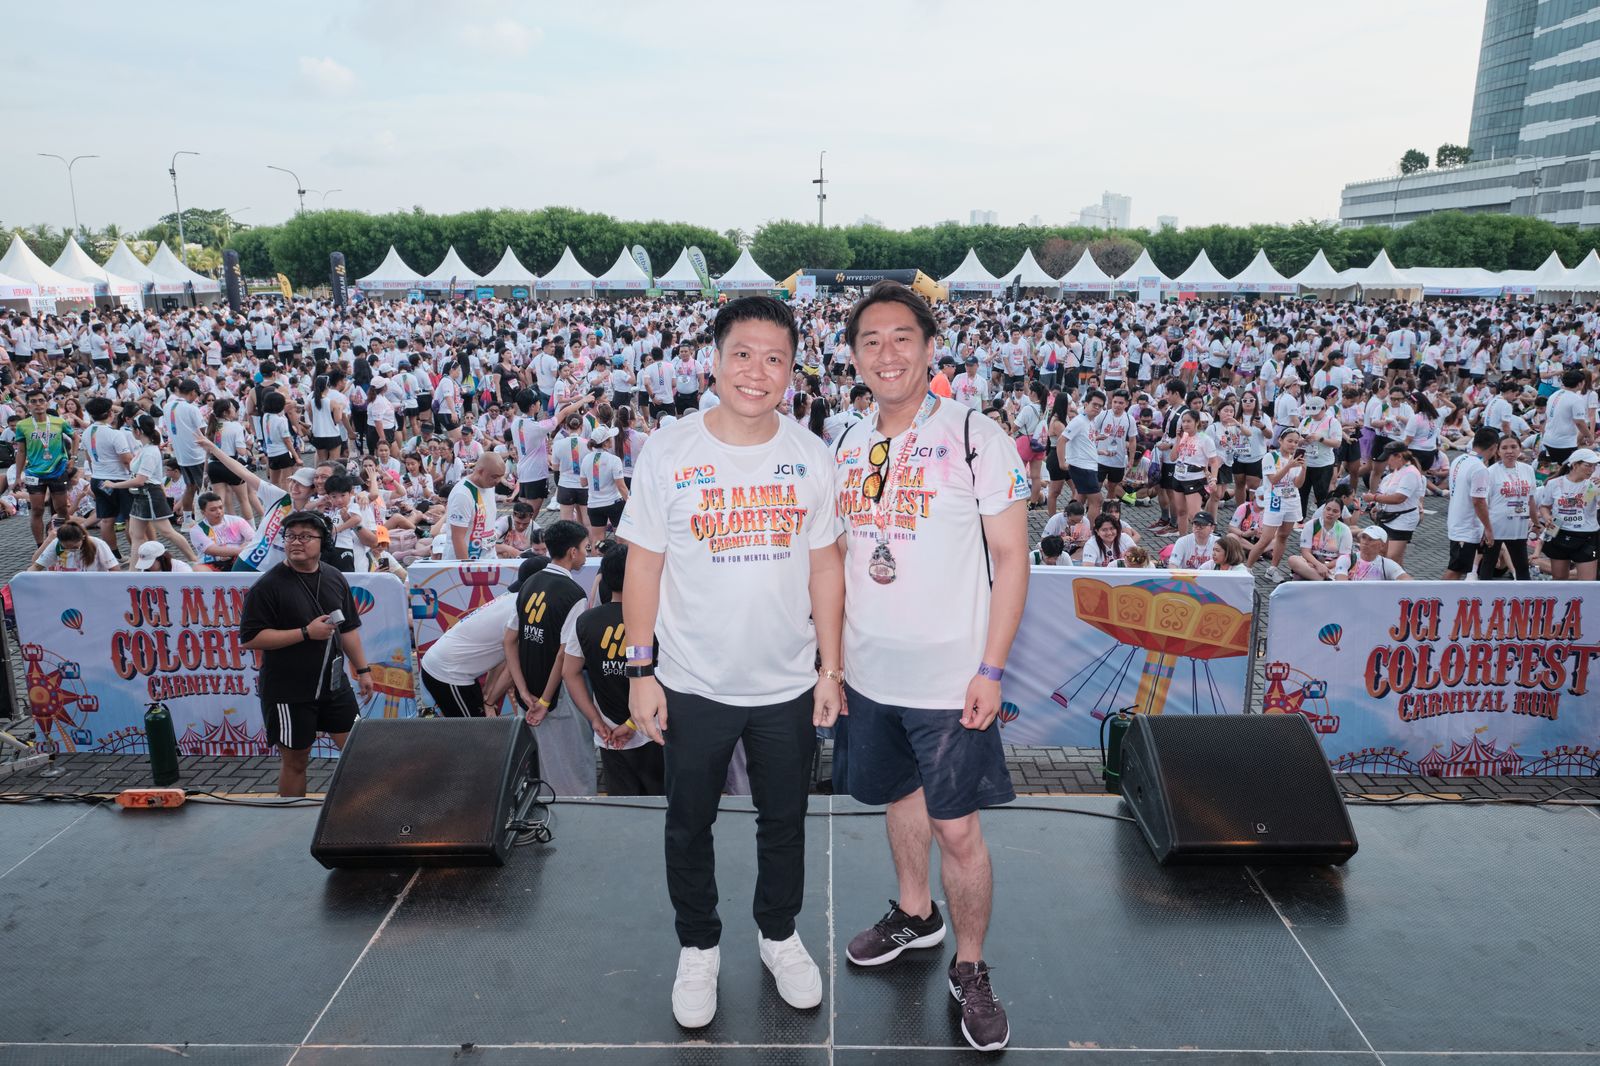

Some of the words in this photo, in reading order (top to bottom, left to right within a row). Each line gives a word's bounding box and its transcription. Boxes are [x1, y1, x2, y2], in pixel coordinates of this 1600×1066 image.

[636, 251, 649, 273] Fitbar
[693, 252, 707, 274] Fitbar
[31, 432, 57, 440] Fibar
[911, 447, 933, 457] JCI
[773, 464, 794, 475] JCI
[676, 477, 711, 490] BEYND
[698, 487, 726, 511] JCI
[730, 484, 799, 509] MANILA
[690, 507, 809, 541] COLORFEST
[708, 534, 768, 553] CARNIVAL
[771, 532, 792, 548] RUN
[712, 555, 725, 564] RUN
[728, 555, 741, 563] FOR
[744, 553, 770, 562] MENTAL
[773, 551, 791, 560] HEALTH
[124, 585, 174, 628] JCI
[180, 586, 252, 628] MAN
[524, 624, 545, 637] HYVE
[1388, 597, 1444, 643] JCI
[1448, 597, 1585, 642] MANILA
[523, 632, 545, 644] SPORTS
[110, 628, 265, 680] COLORF
[602, 660, 627, 670] HYV
[603, 668, 627, 677] SPORT
[1363, 642, 1600, 698] COLORFEST
[147, 674, 250, 701] CARNIVAL
[1397, 690, 1510, 722] CARNIVAL
[1512, 690, 1562, 721] RUN
